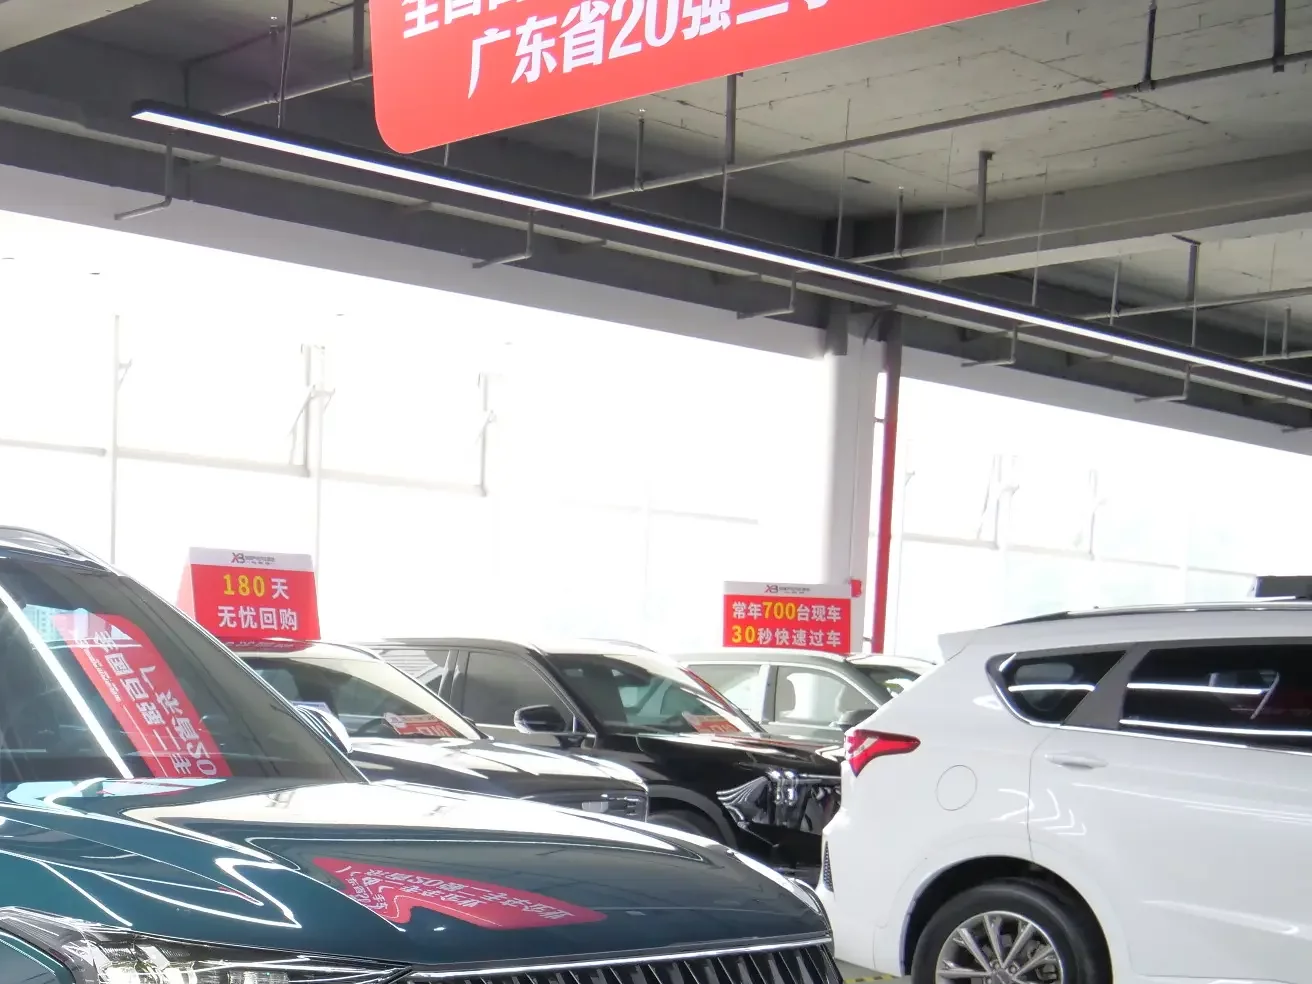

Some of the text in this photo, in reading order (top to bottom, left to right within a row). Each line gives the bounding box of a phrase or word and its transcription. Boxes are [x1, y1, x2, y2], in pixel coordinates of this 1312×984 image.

[217, 605, 298, 631] 无忧回购
[732, 601, 842, 622] 常年700台现车
[731, 625, 842, 647] 30秒快速过车
